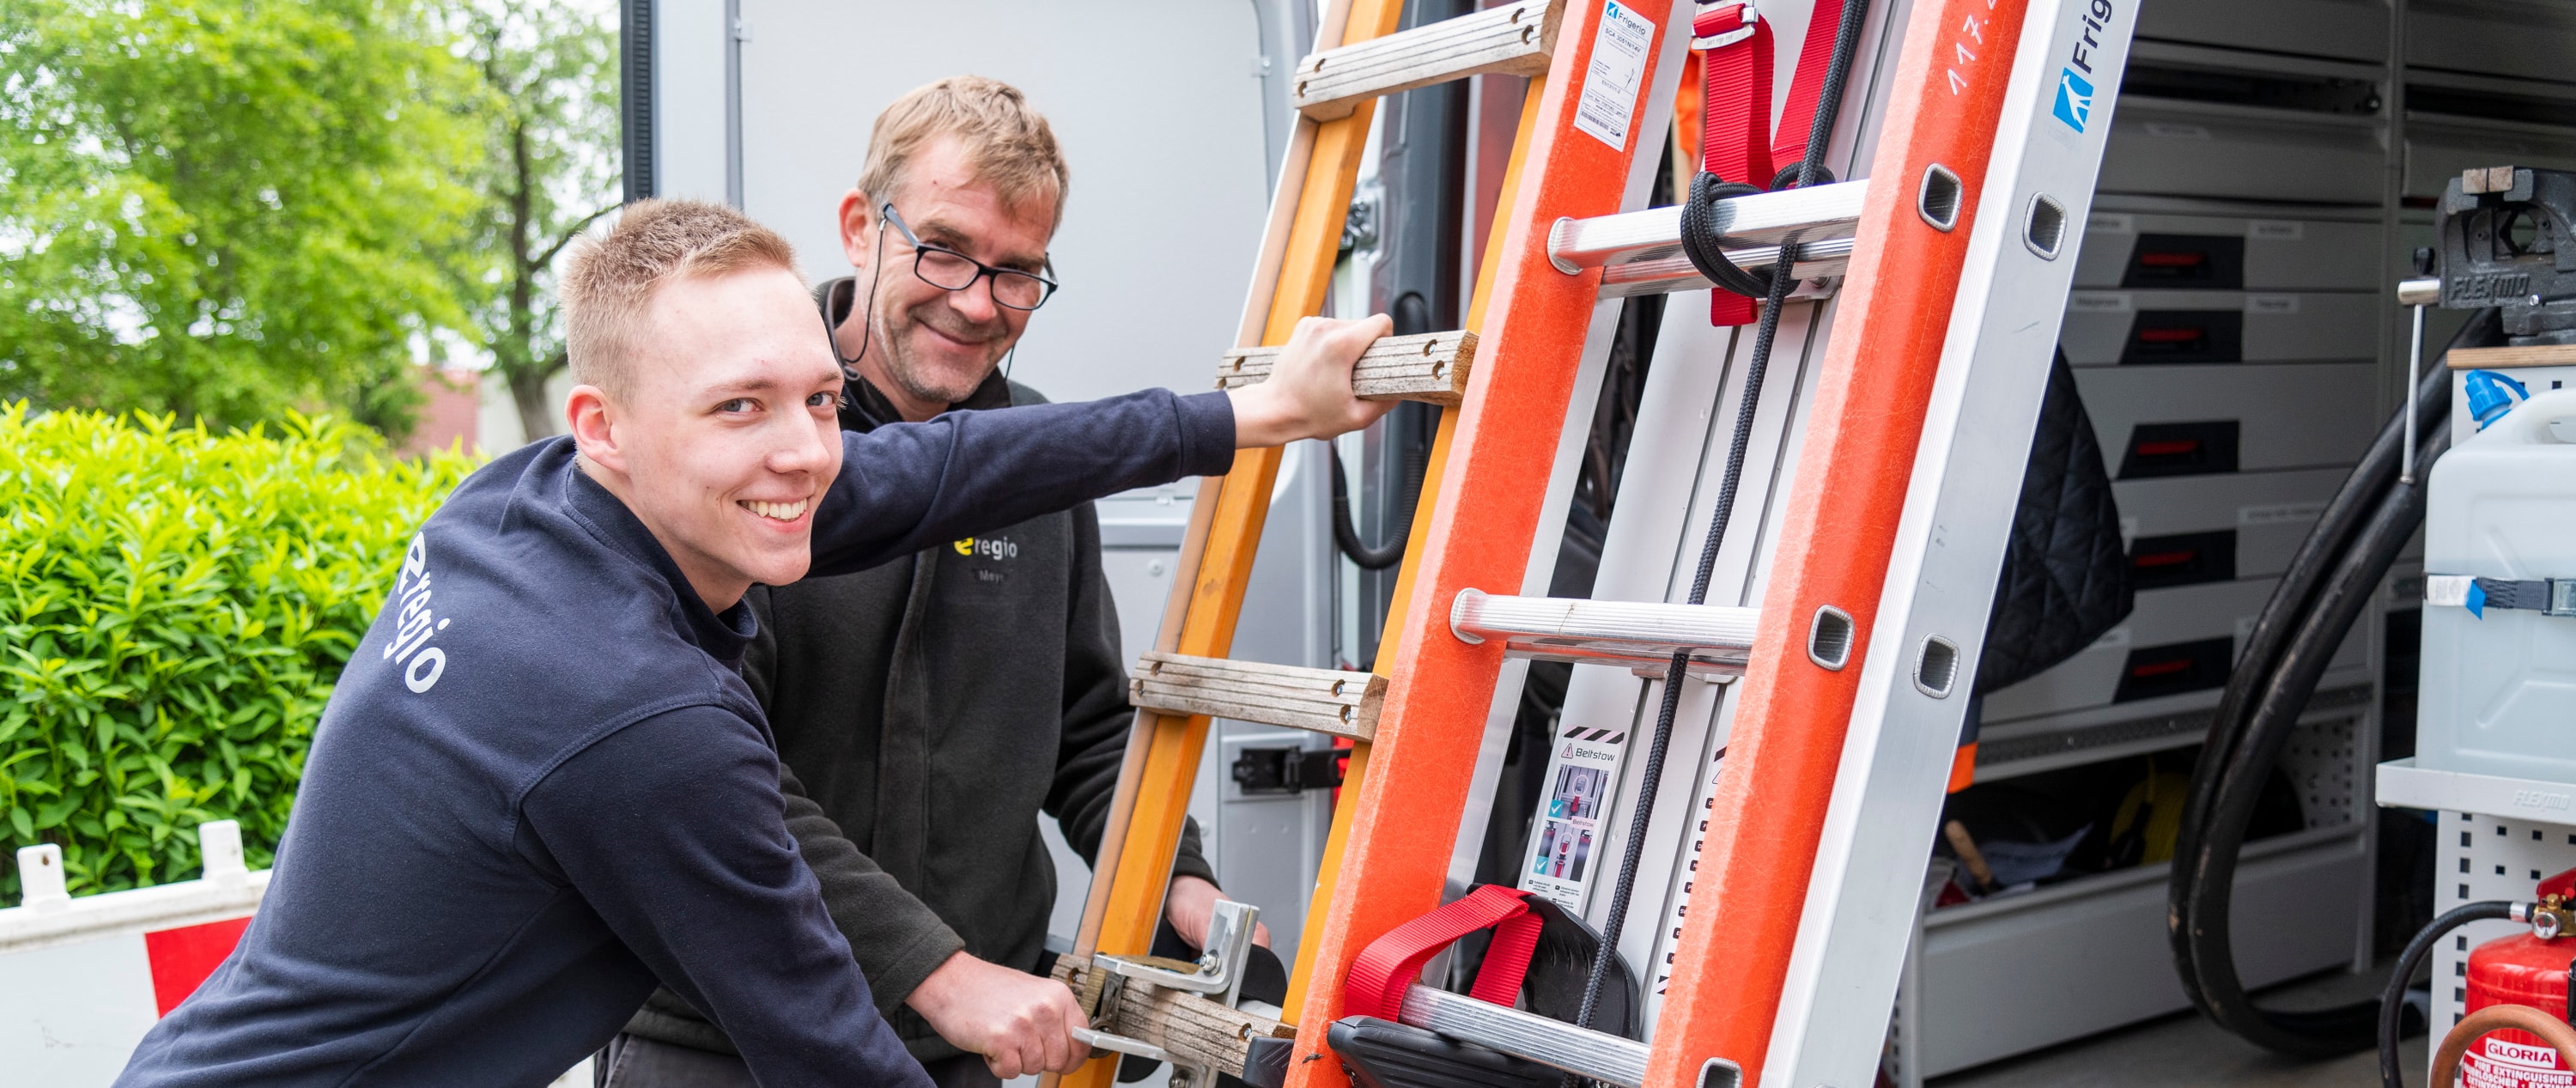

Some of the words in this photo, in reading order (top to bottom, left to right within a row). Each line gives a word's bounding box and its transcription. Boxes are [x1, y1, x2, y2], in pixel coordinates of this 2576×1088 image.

[1618, 12, 1646, 35] Frigerio
[1576, 748, 1616, 762] Beltstow
[1572, 818, 1595, 828] Beltstow
[2488, 1042, 2553, 1063] GLORIA
[2474, 1060, 2492, 1074] FIRE
[2494, 1065, 2573, 1085] EXTINGUISHER
